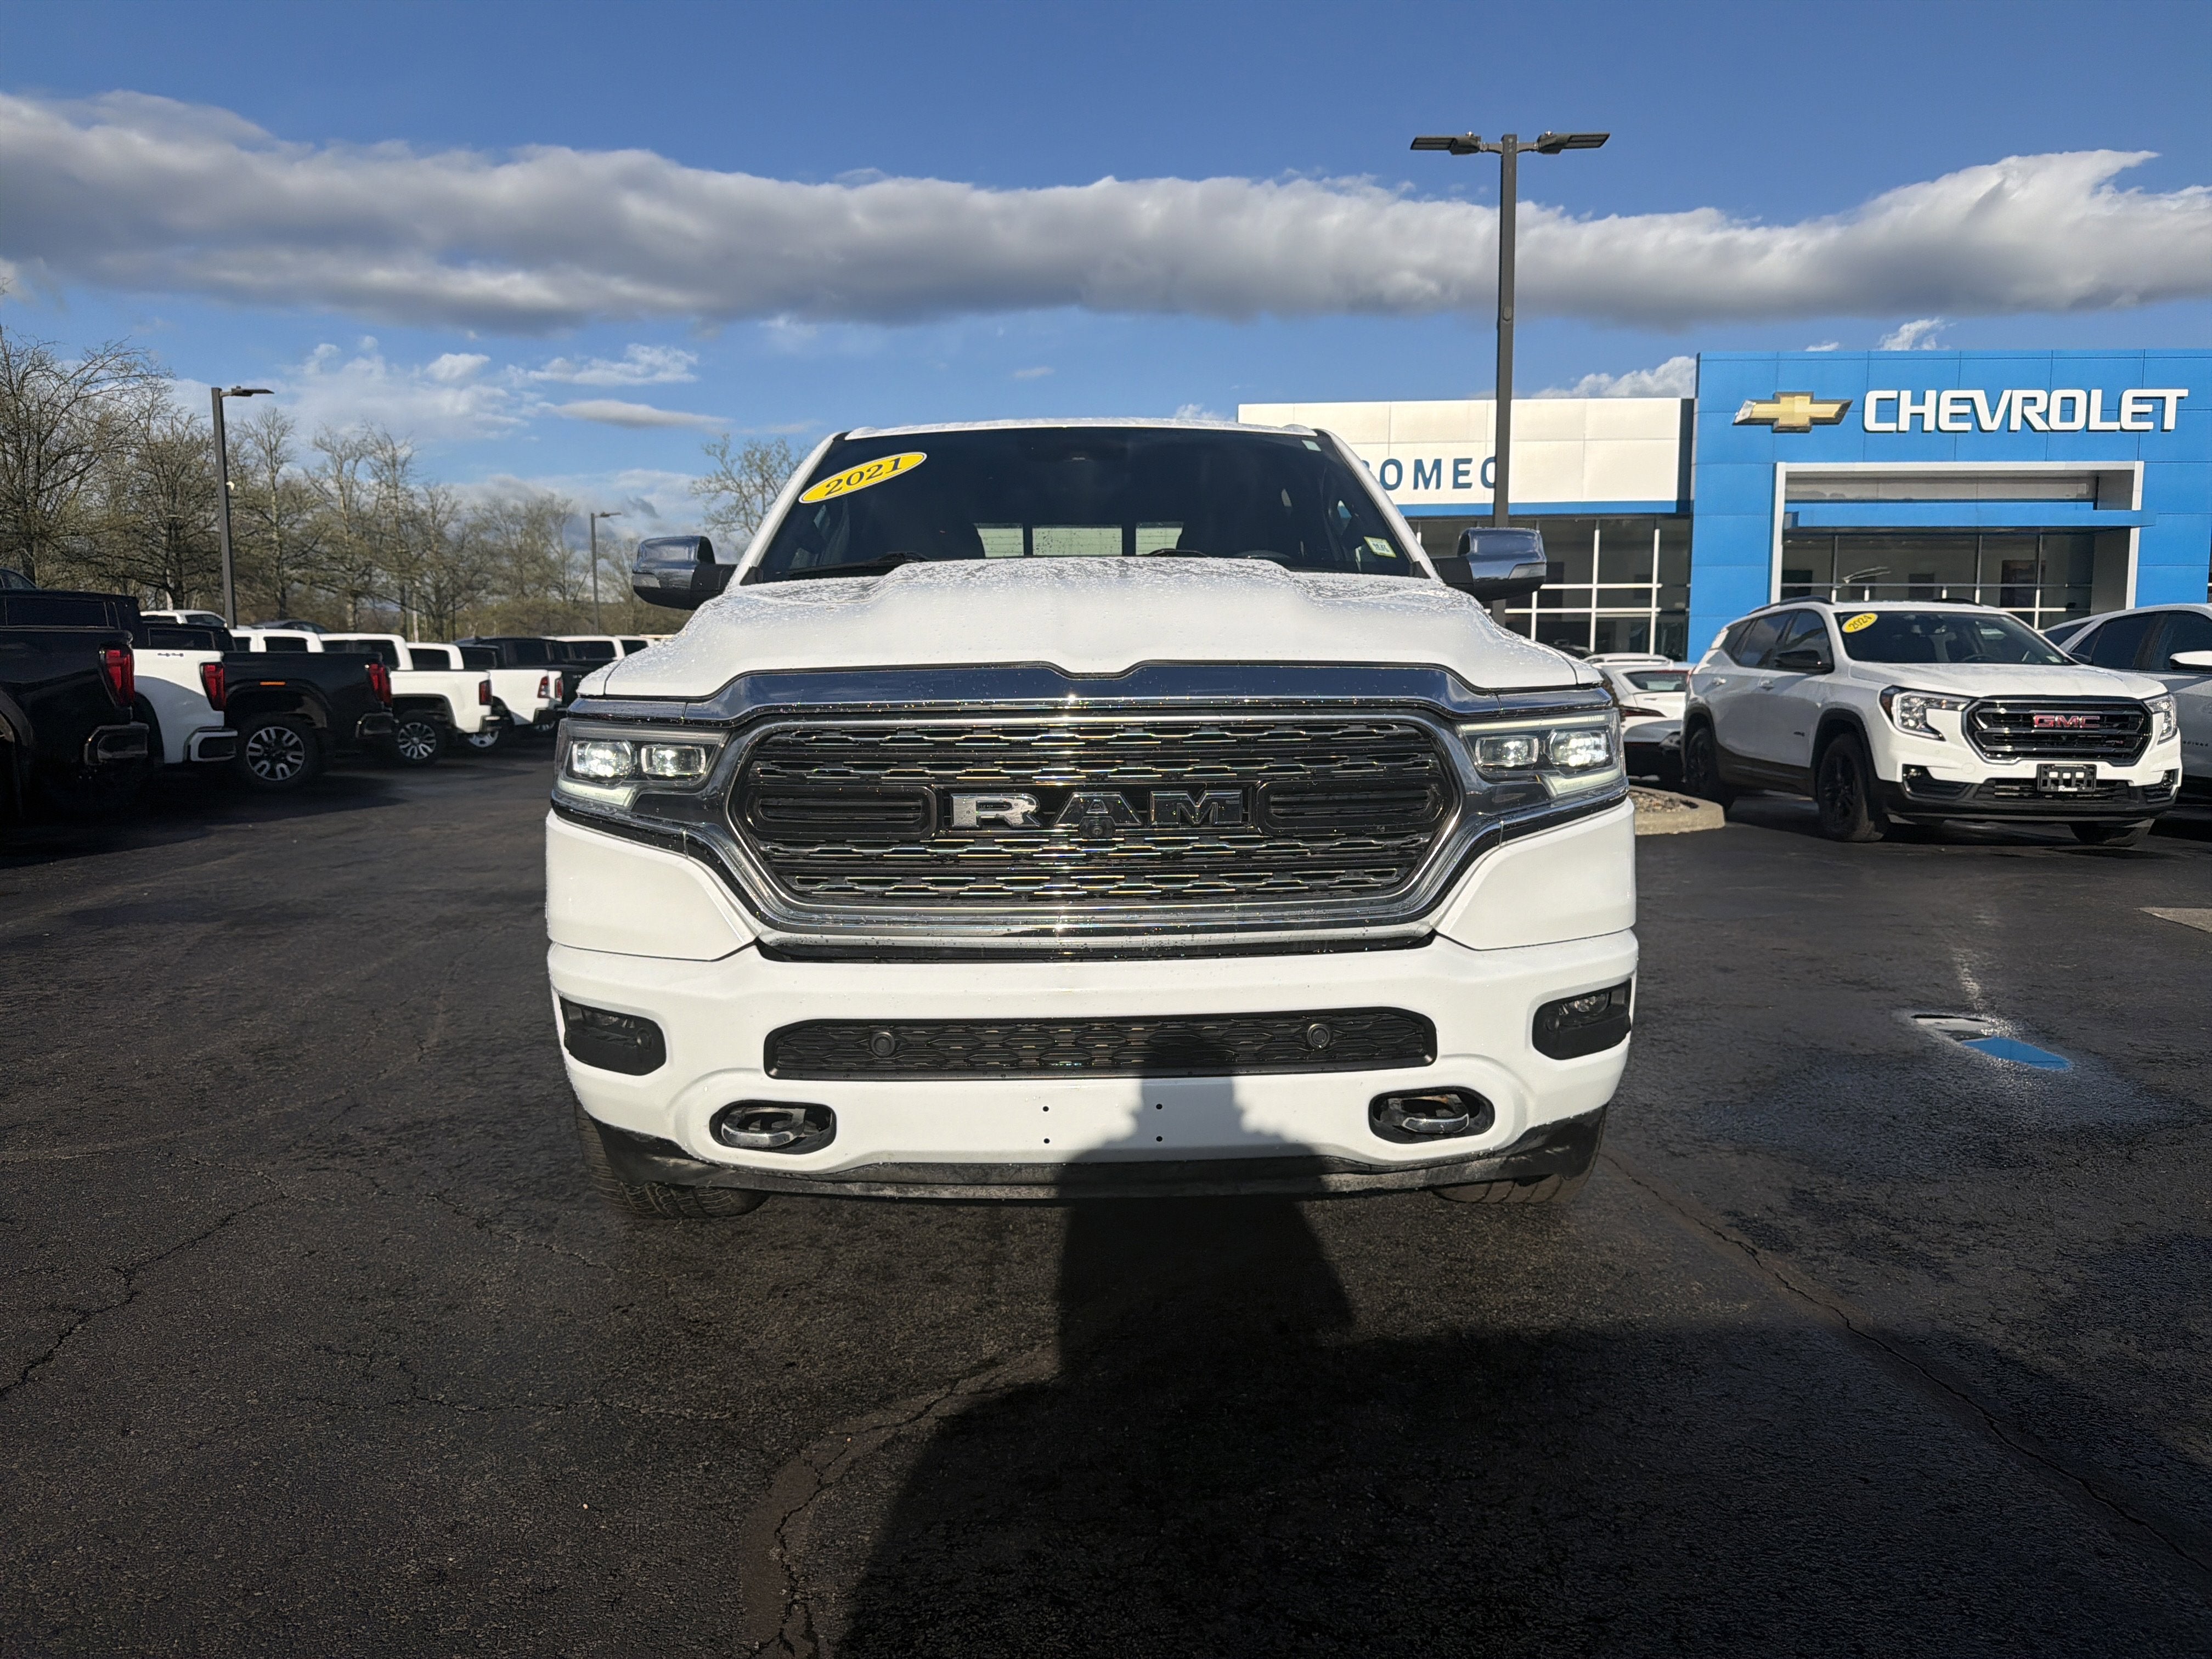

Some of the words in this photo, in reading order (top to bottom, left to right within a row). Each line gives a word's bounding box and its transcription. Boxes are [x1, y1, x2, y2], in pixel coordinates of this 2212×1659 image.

[1864, 389, 2189, 432] CHEVROLET
[824, 457, 902, 496] 2021
[1361, 456, 1496, 491] OMEO
[2033, 715, 2100, 728] GMC
[950, 789, 1244, 828] RAM
